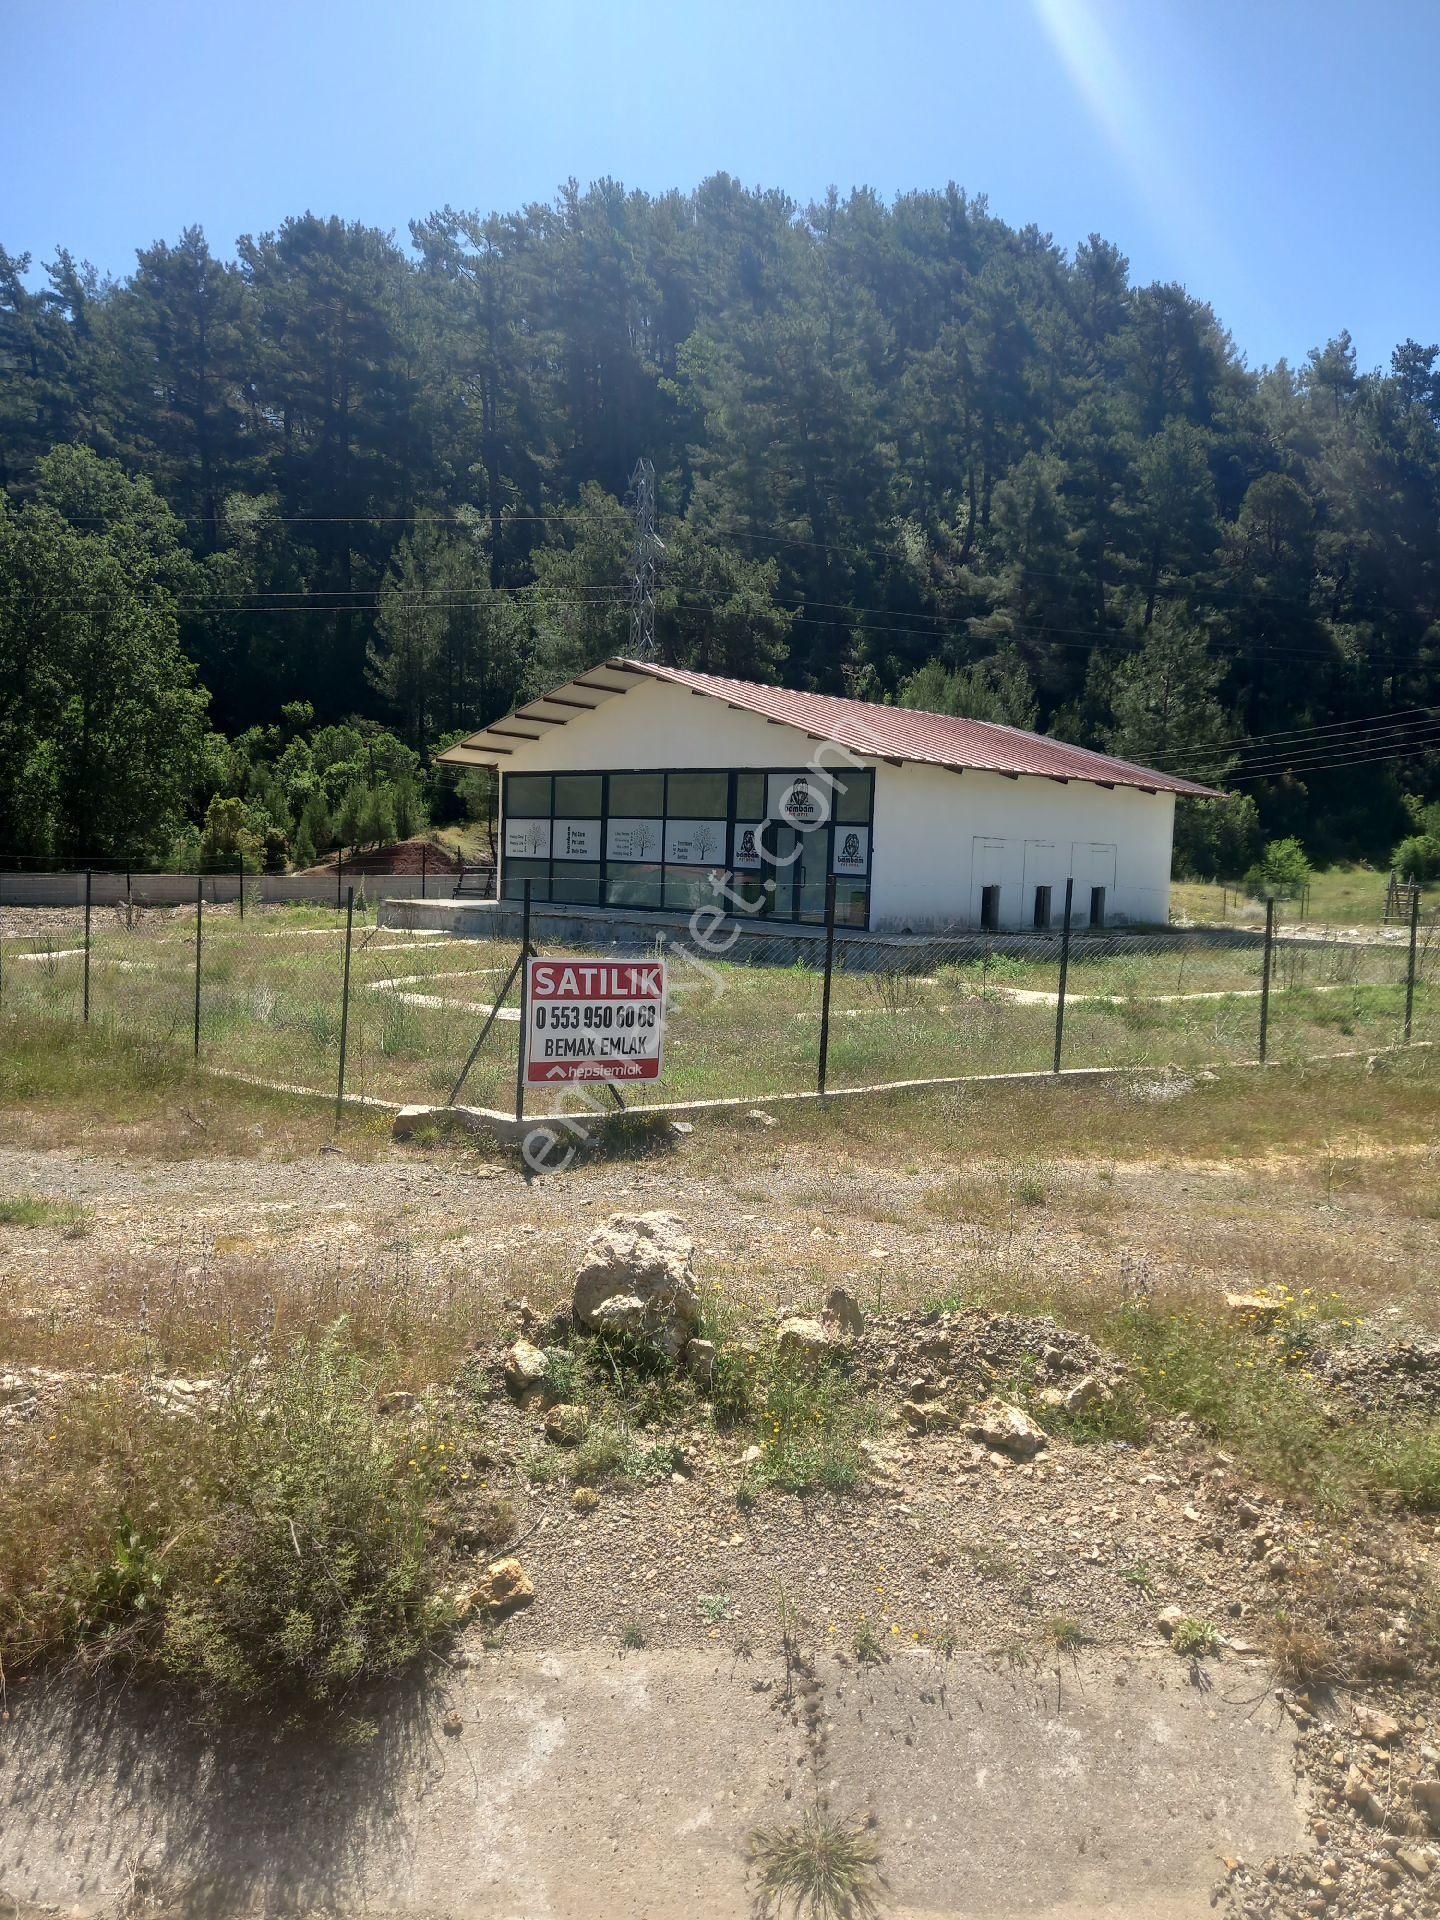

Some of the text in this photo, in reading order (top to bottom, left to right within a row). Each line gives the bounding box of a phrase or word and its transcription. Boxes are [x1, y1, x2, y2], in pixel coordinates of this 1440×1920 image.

[837, 855, 864, 864] bambam
[535, 967, 661, 996] SATILIK
[536, 1005, 656, 1030] 0 553 950 60 68
[544, 1035, 647, 1057] BEMAX EMLAK
[568, 1064, 643, 1079] hepsiemlak
